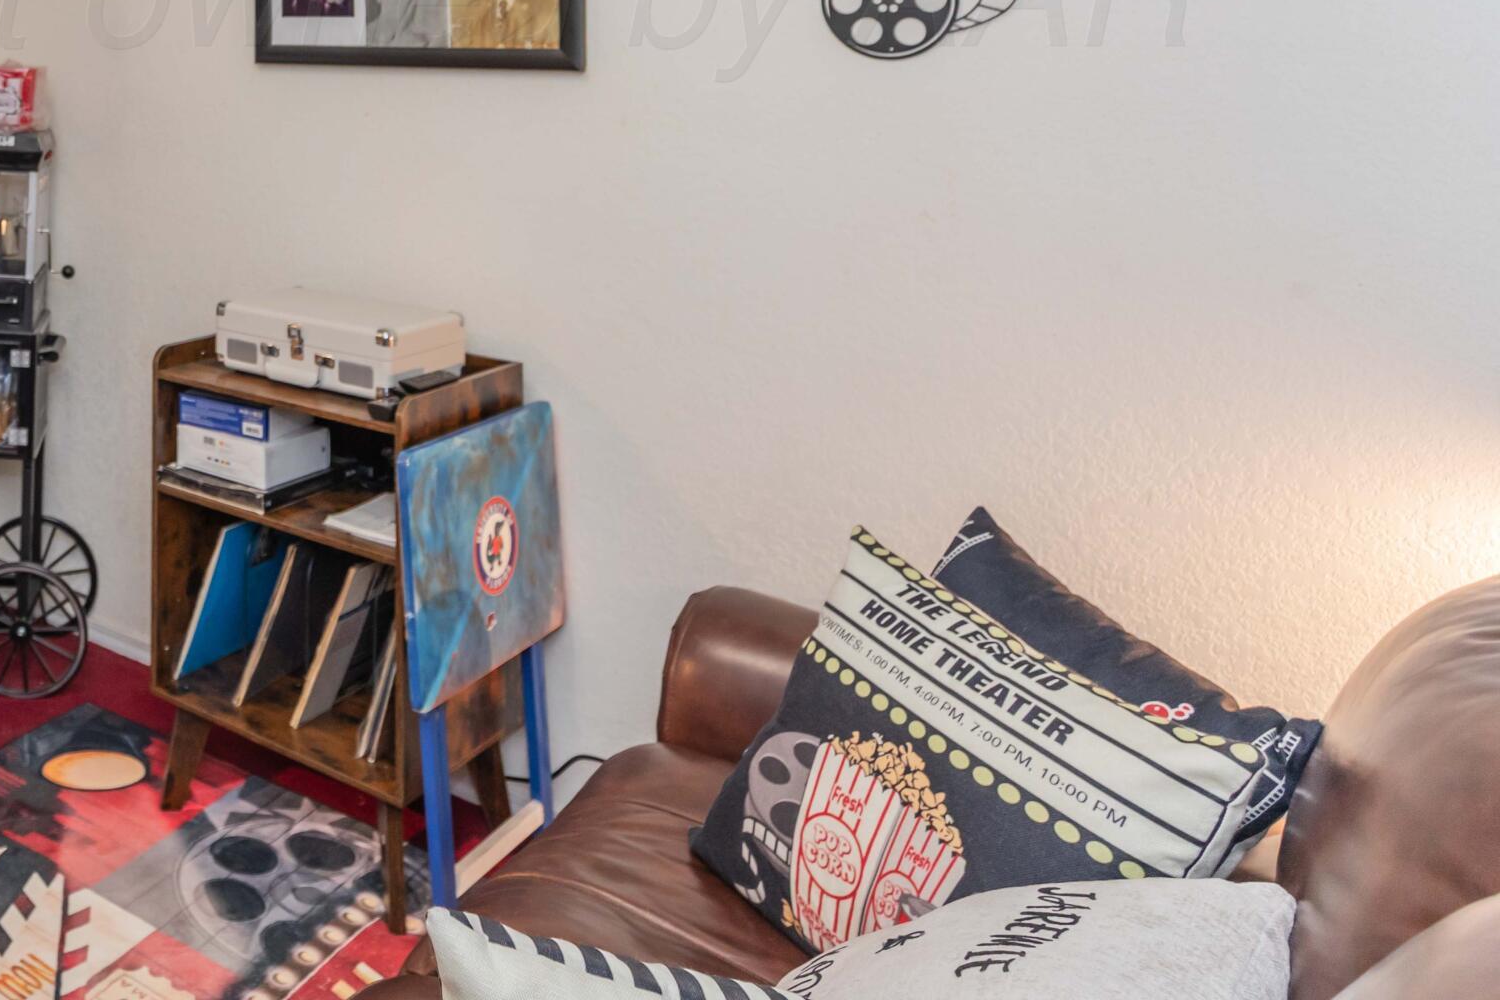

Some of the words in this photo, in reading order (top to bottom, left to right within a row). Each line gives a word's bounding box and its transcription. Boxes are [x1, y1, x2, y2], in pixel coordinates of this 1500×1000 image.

[896, 584, 949, 620] THE
[860, 599, 933, 655] HOME
[934, 640, 1075, 746] THEATER
[864, 649, 888, 670] 1:00
[913, 685, 939, 707] 4:00
[969, 719, 1002, 748] 7:00
[1040, 766, 1089, 805] 10:00
[1092, 800, 1128, 828] PM
[832, 786, 864, 814] Fresh
[813, 822, 851, 857] POP
[805, 842, 856, 884] CORN
[905, 846, 931, 871] Fresh
